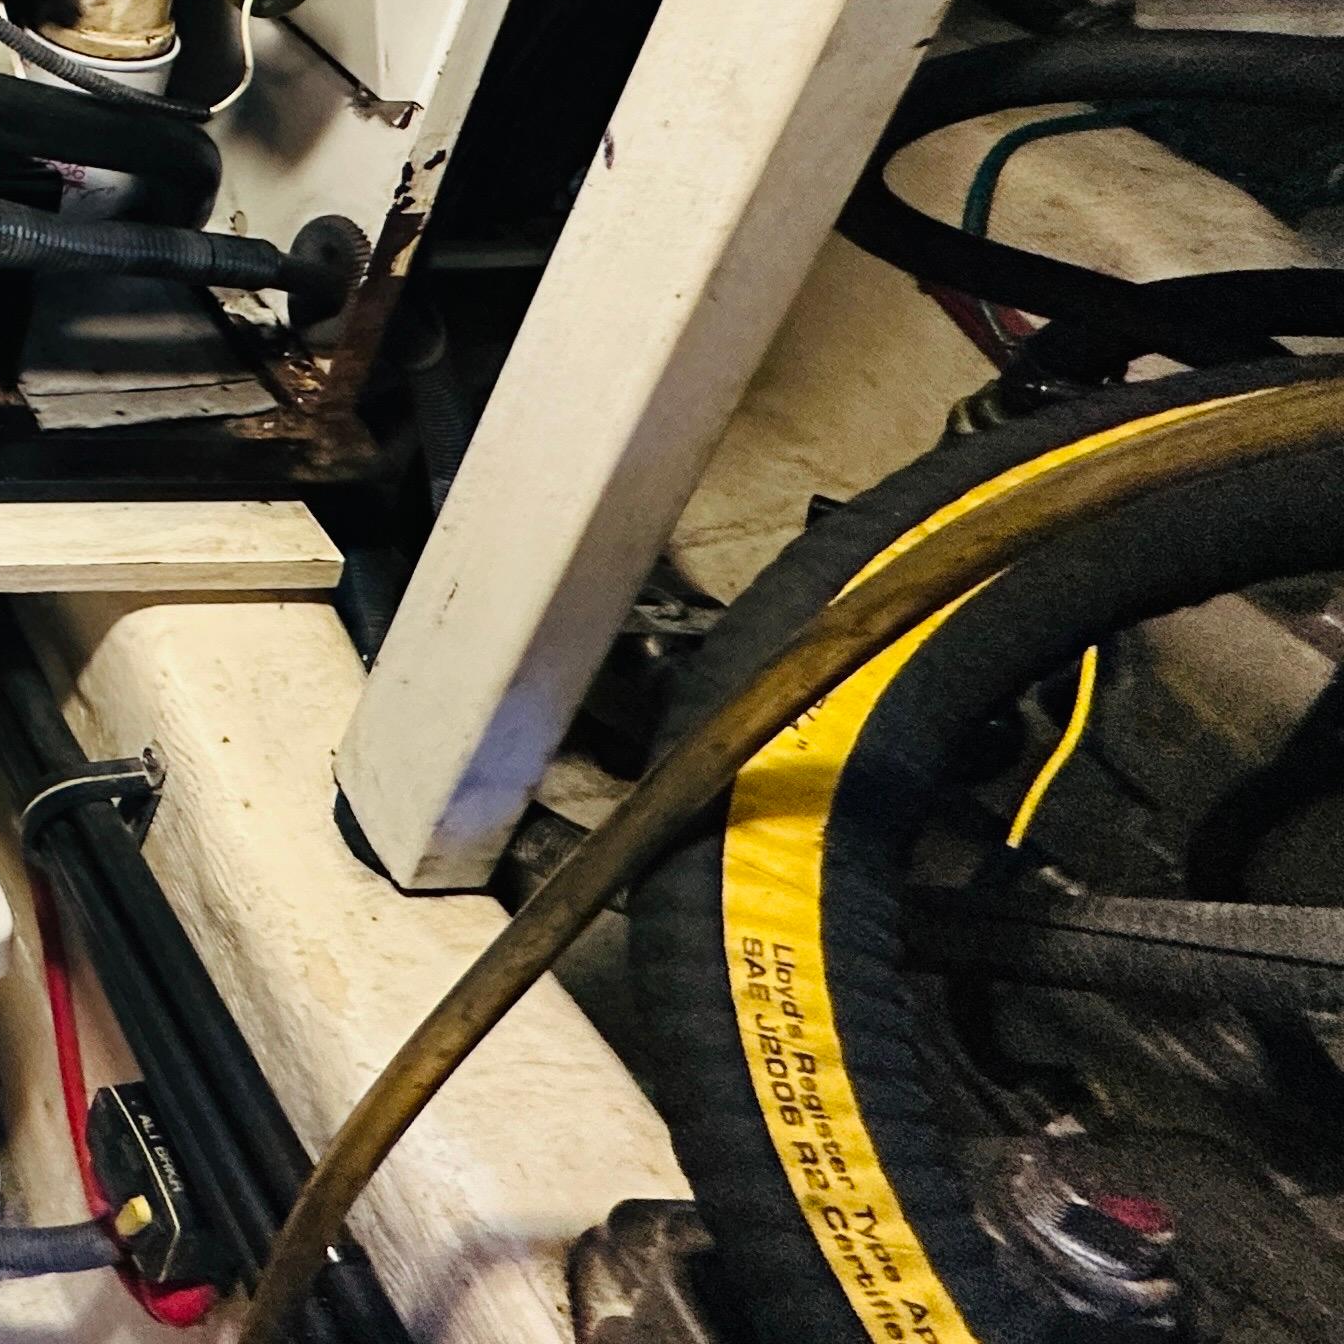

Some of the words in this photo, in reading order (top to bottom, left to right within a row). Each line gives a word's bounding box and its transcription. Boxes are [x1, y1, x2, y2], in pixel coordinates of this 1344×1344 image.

[742, 936, 771, 1004] SAE
[756, 1013, 804, 1127] J2006
[772, 943, 805, 1040] Lloyd's
[791, 1052, 855, 1191] Register
[854, 1203, 903, 1284] Type
[792, 1141, 831, 1191] R2
